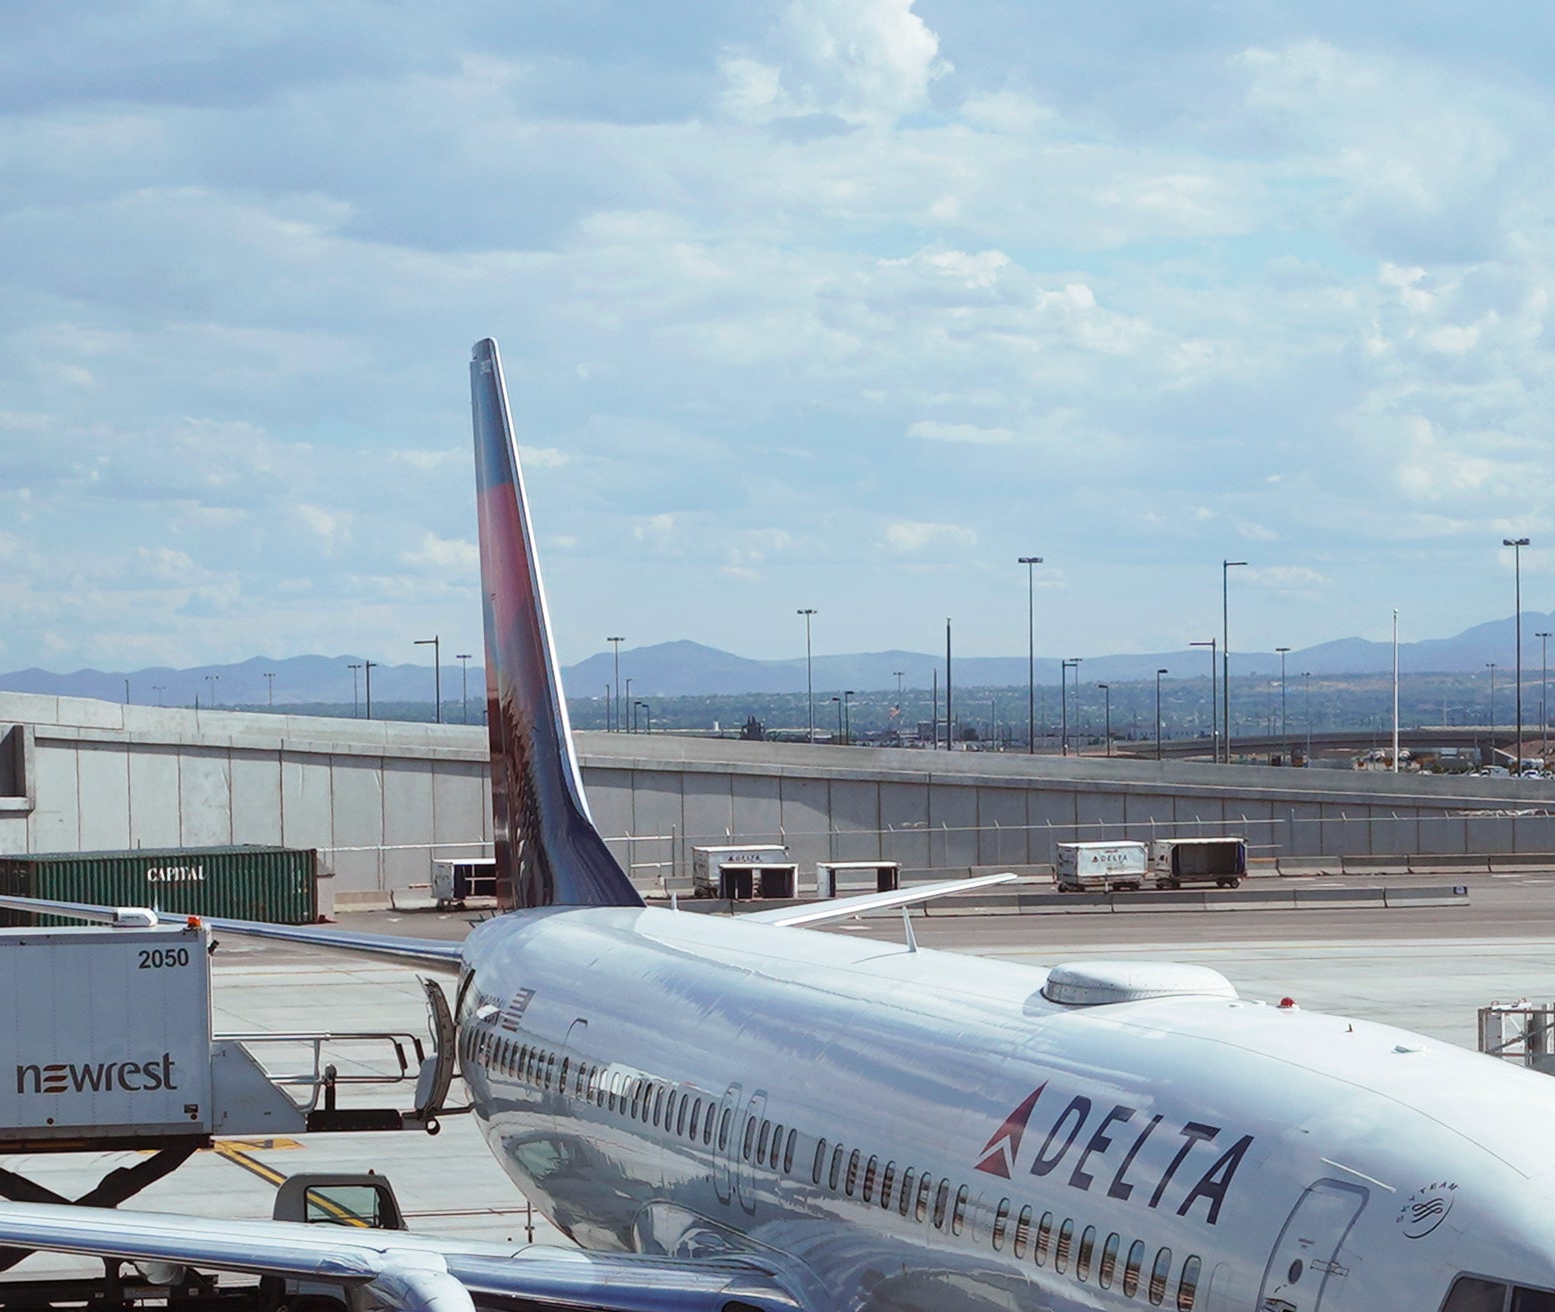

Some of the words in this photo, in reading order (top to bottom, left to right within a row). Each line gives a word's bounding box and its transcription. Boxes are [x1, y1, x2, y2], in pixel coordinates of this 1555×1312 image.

[147, 865, 205, 882] CAPITAL
[139, 948, 189, 969] 2050
[17, 1052, 178, 1094] newrest
[1030, 1095, 1254, 1225] DELTA
